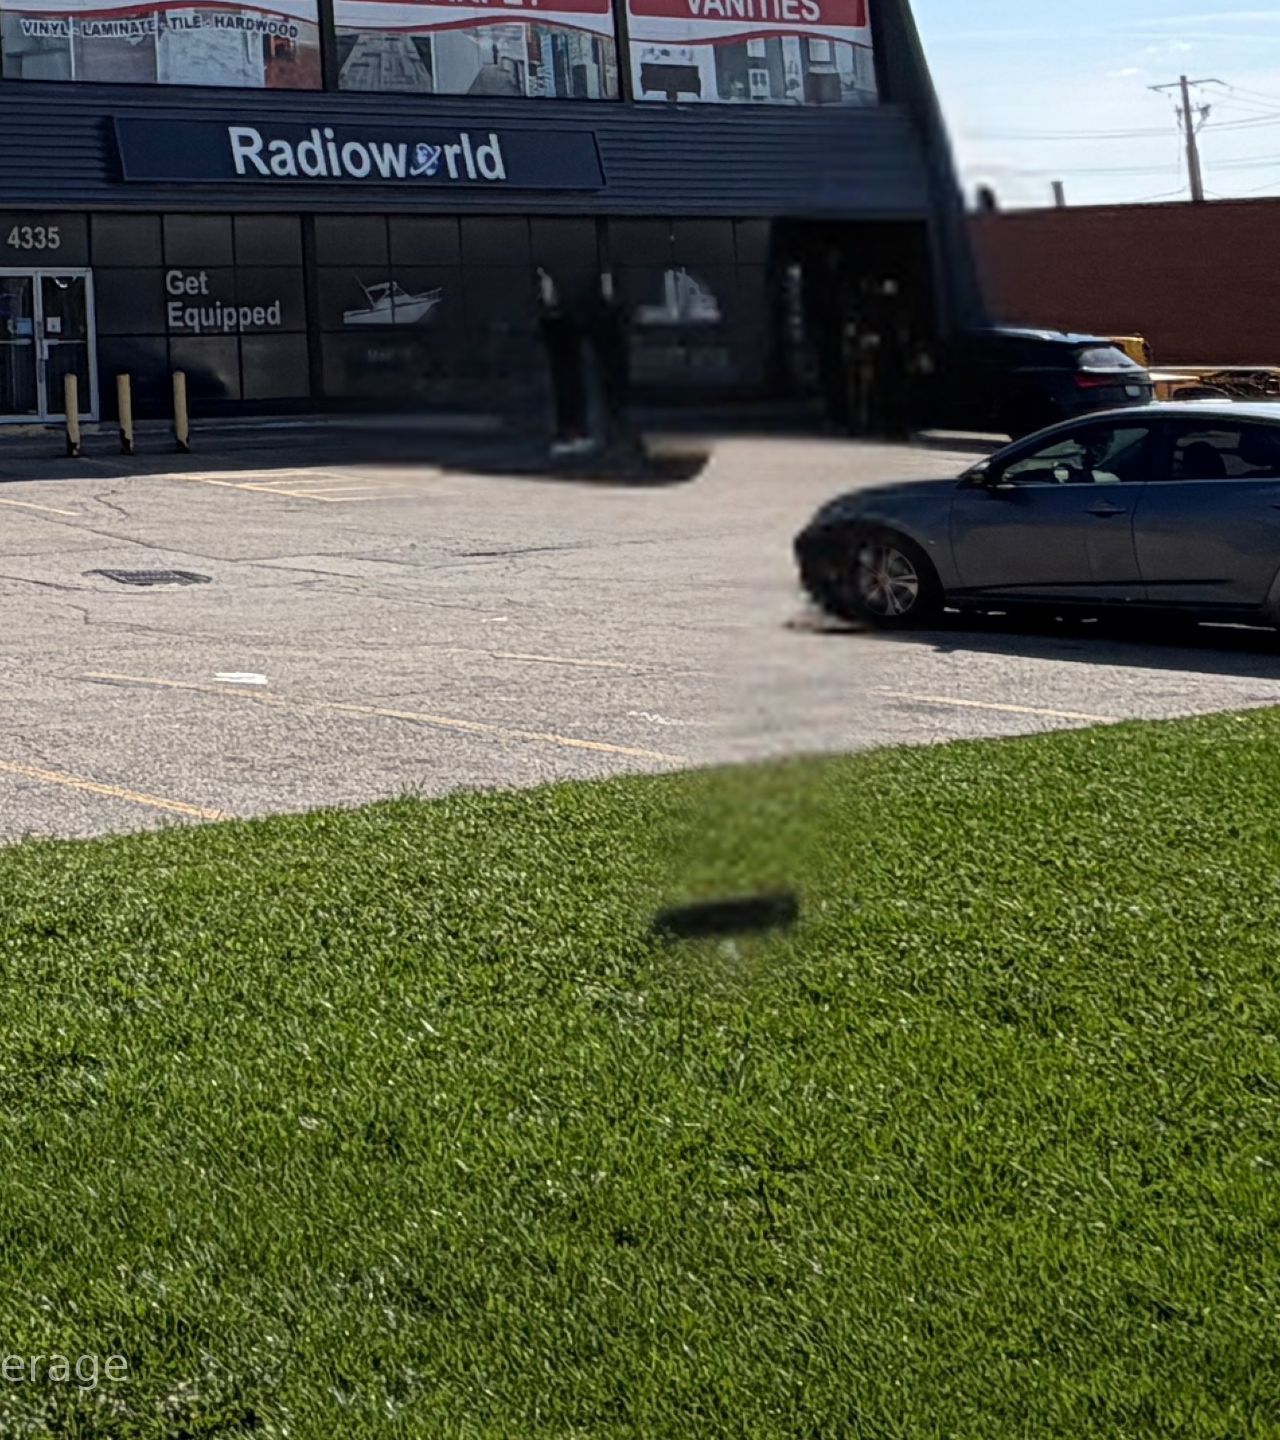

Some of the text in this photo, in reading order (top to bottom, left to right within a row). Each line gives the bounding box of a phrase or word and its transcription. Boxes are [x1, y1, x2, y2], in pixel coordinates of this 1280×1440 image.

[21, 15, 299, 38] VINYL LAMINATE TILE HARDWOOD
[7, 227, 61, 250] 4335
[165, 269, 209, 296] Get
[168, 300, 281, 333] Equipped
